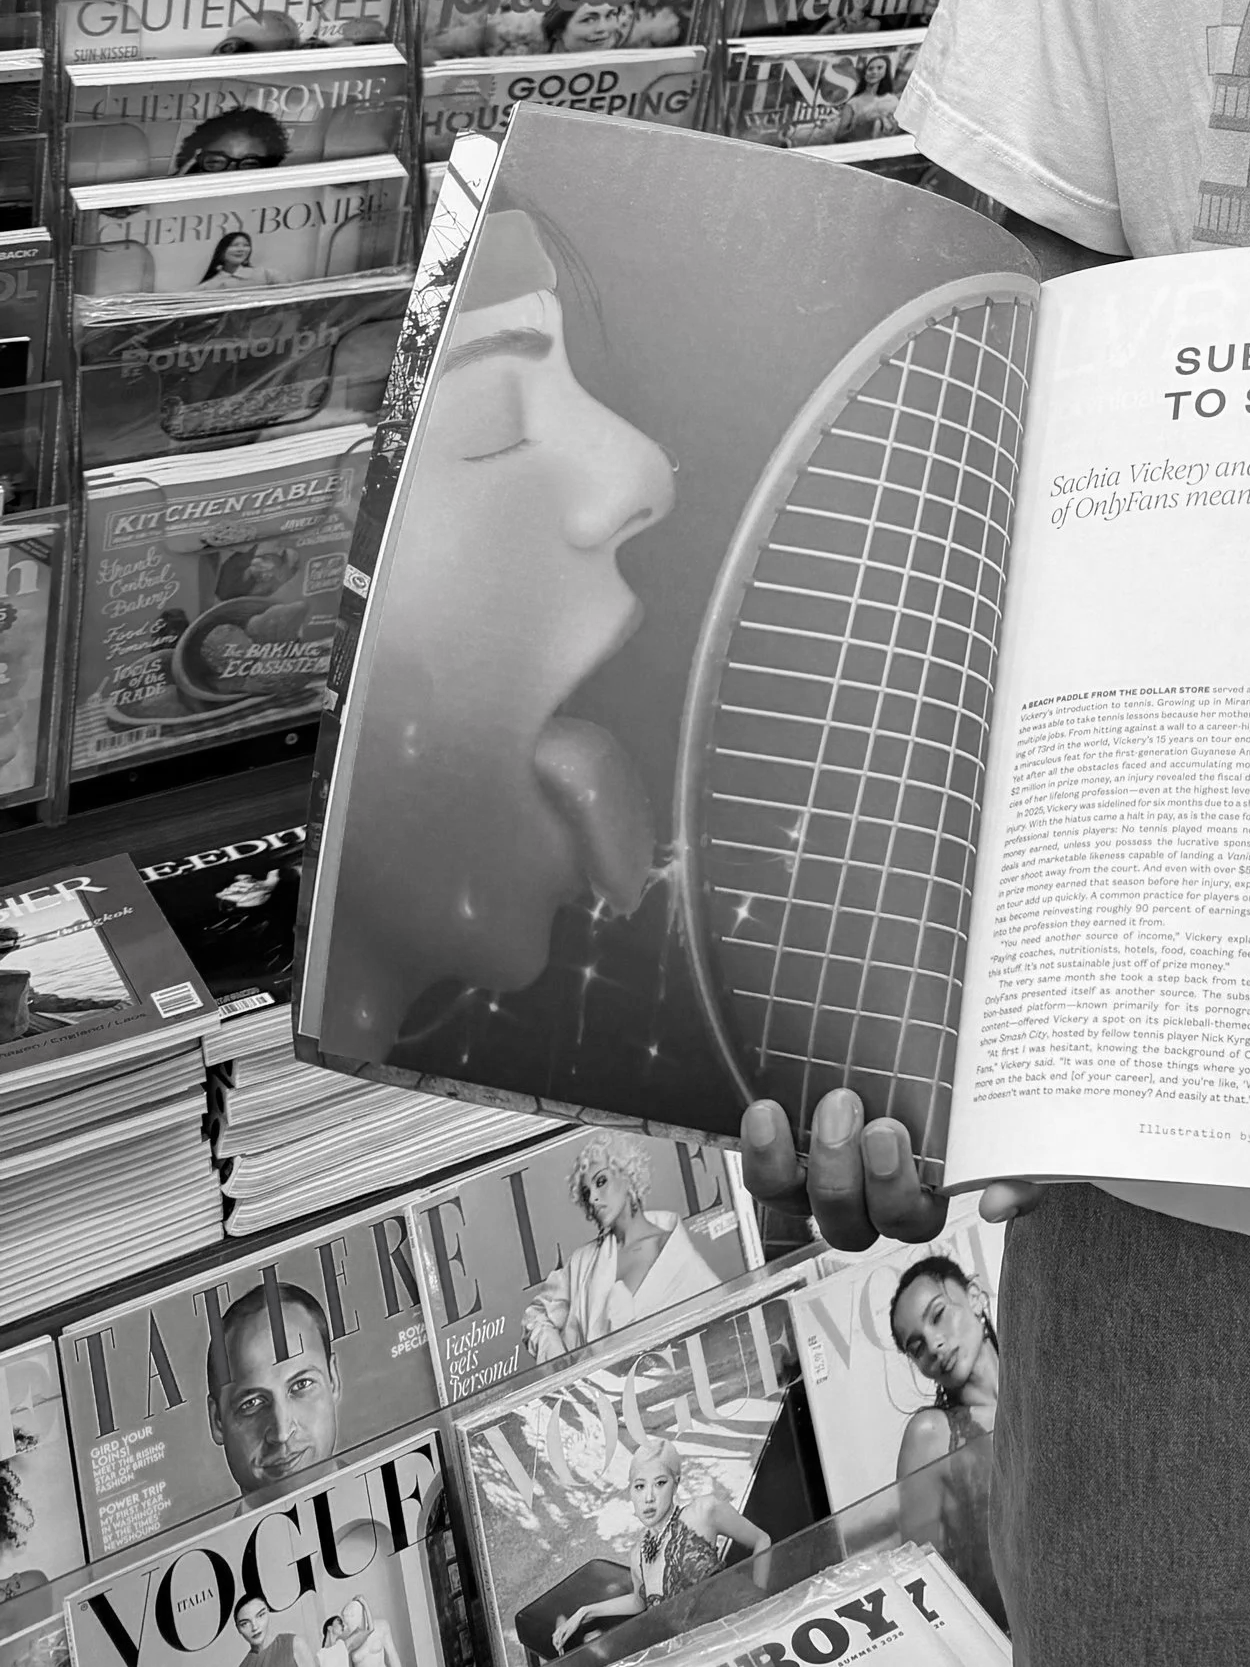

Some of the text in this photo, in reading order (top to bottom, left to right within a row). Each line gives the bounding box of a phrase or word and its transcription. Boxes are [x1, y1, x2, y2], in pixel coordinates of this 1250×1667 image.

[74, 46, 138, 62] SUN-KISSED
[508, 71, 619, 101] GOOD
[1164, 388, 1227, 421] TO
[1050, 467, 1121, 498] Sachia
[1130, 459, 1210, 486] Vickery
[115, 494, 249, 536] KITCHEN
[252, 474, 344, 508] TABLE
[1051, 497, 1075, 530] of
[1075, 490, 1180, 522] OnlyFans
[1029, 697, 1055, 709] BEACH
[1056, 692, 1089, 703] PADDLE
[1091, 690, 1117, 699] FROM
[1119, 688, 1138, 696] THE
[1139, 687, 1177, 696] DOLLAR
[1179, 686, 1210, 694] STORE
[1139, 1124, 1231, 1140] Illustration
[74, 1215, 421, 1439] TATLER
[446, 1315, 506, 1361] Fashion
[449, 1350, 480, 1378] gets
[450, 1345, 520, 1402] personal
[94, 1471, 135, 1496] FASHION
[98, 1482, 167, 1518] POWER TRIP
[77, 1444, 436, 1667] VOGUE
[177, 1587, 214, 1614] ITALIA
[837, 1631, 905, 1667] SUMMER 2026
